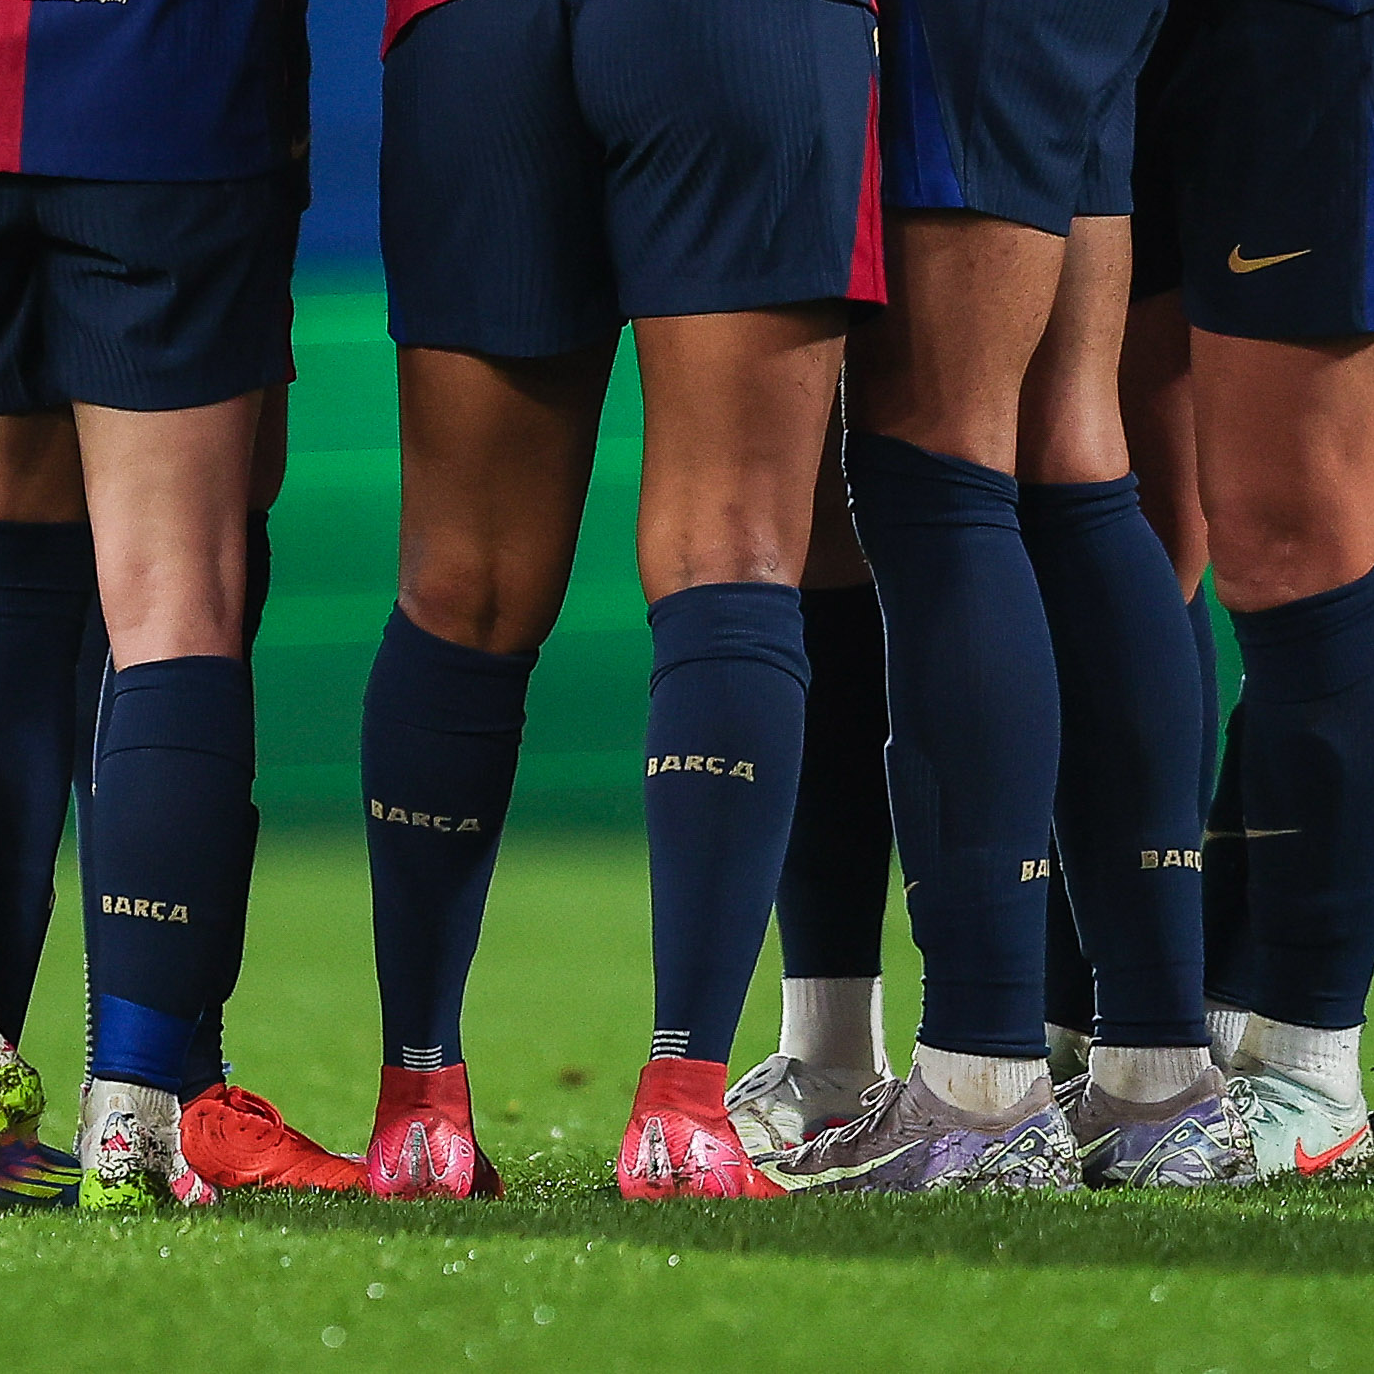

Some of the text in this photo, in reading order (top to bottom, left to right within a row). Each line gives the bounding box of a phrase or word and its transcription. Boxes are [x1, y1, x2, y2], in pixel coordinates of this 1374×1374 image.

[647, 755, 755, 782] BARÇA
[371, 799, 481, 832] BARÇA
[1020, 859, 1050, 882] BA
[102, 895, 188, 924] BARÇA
